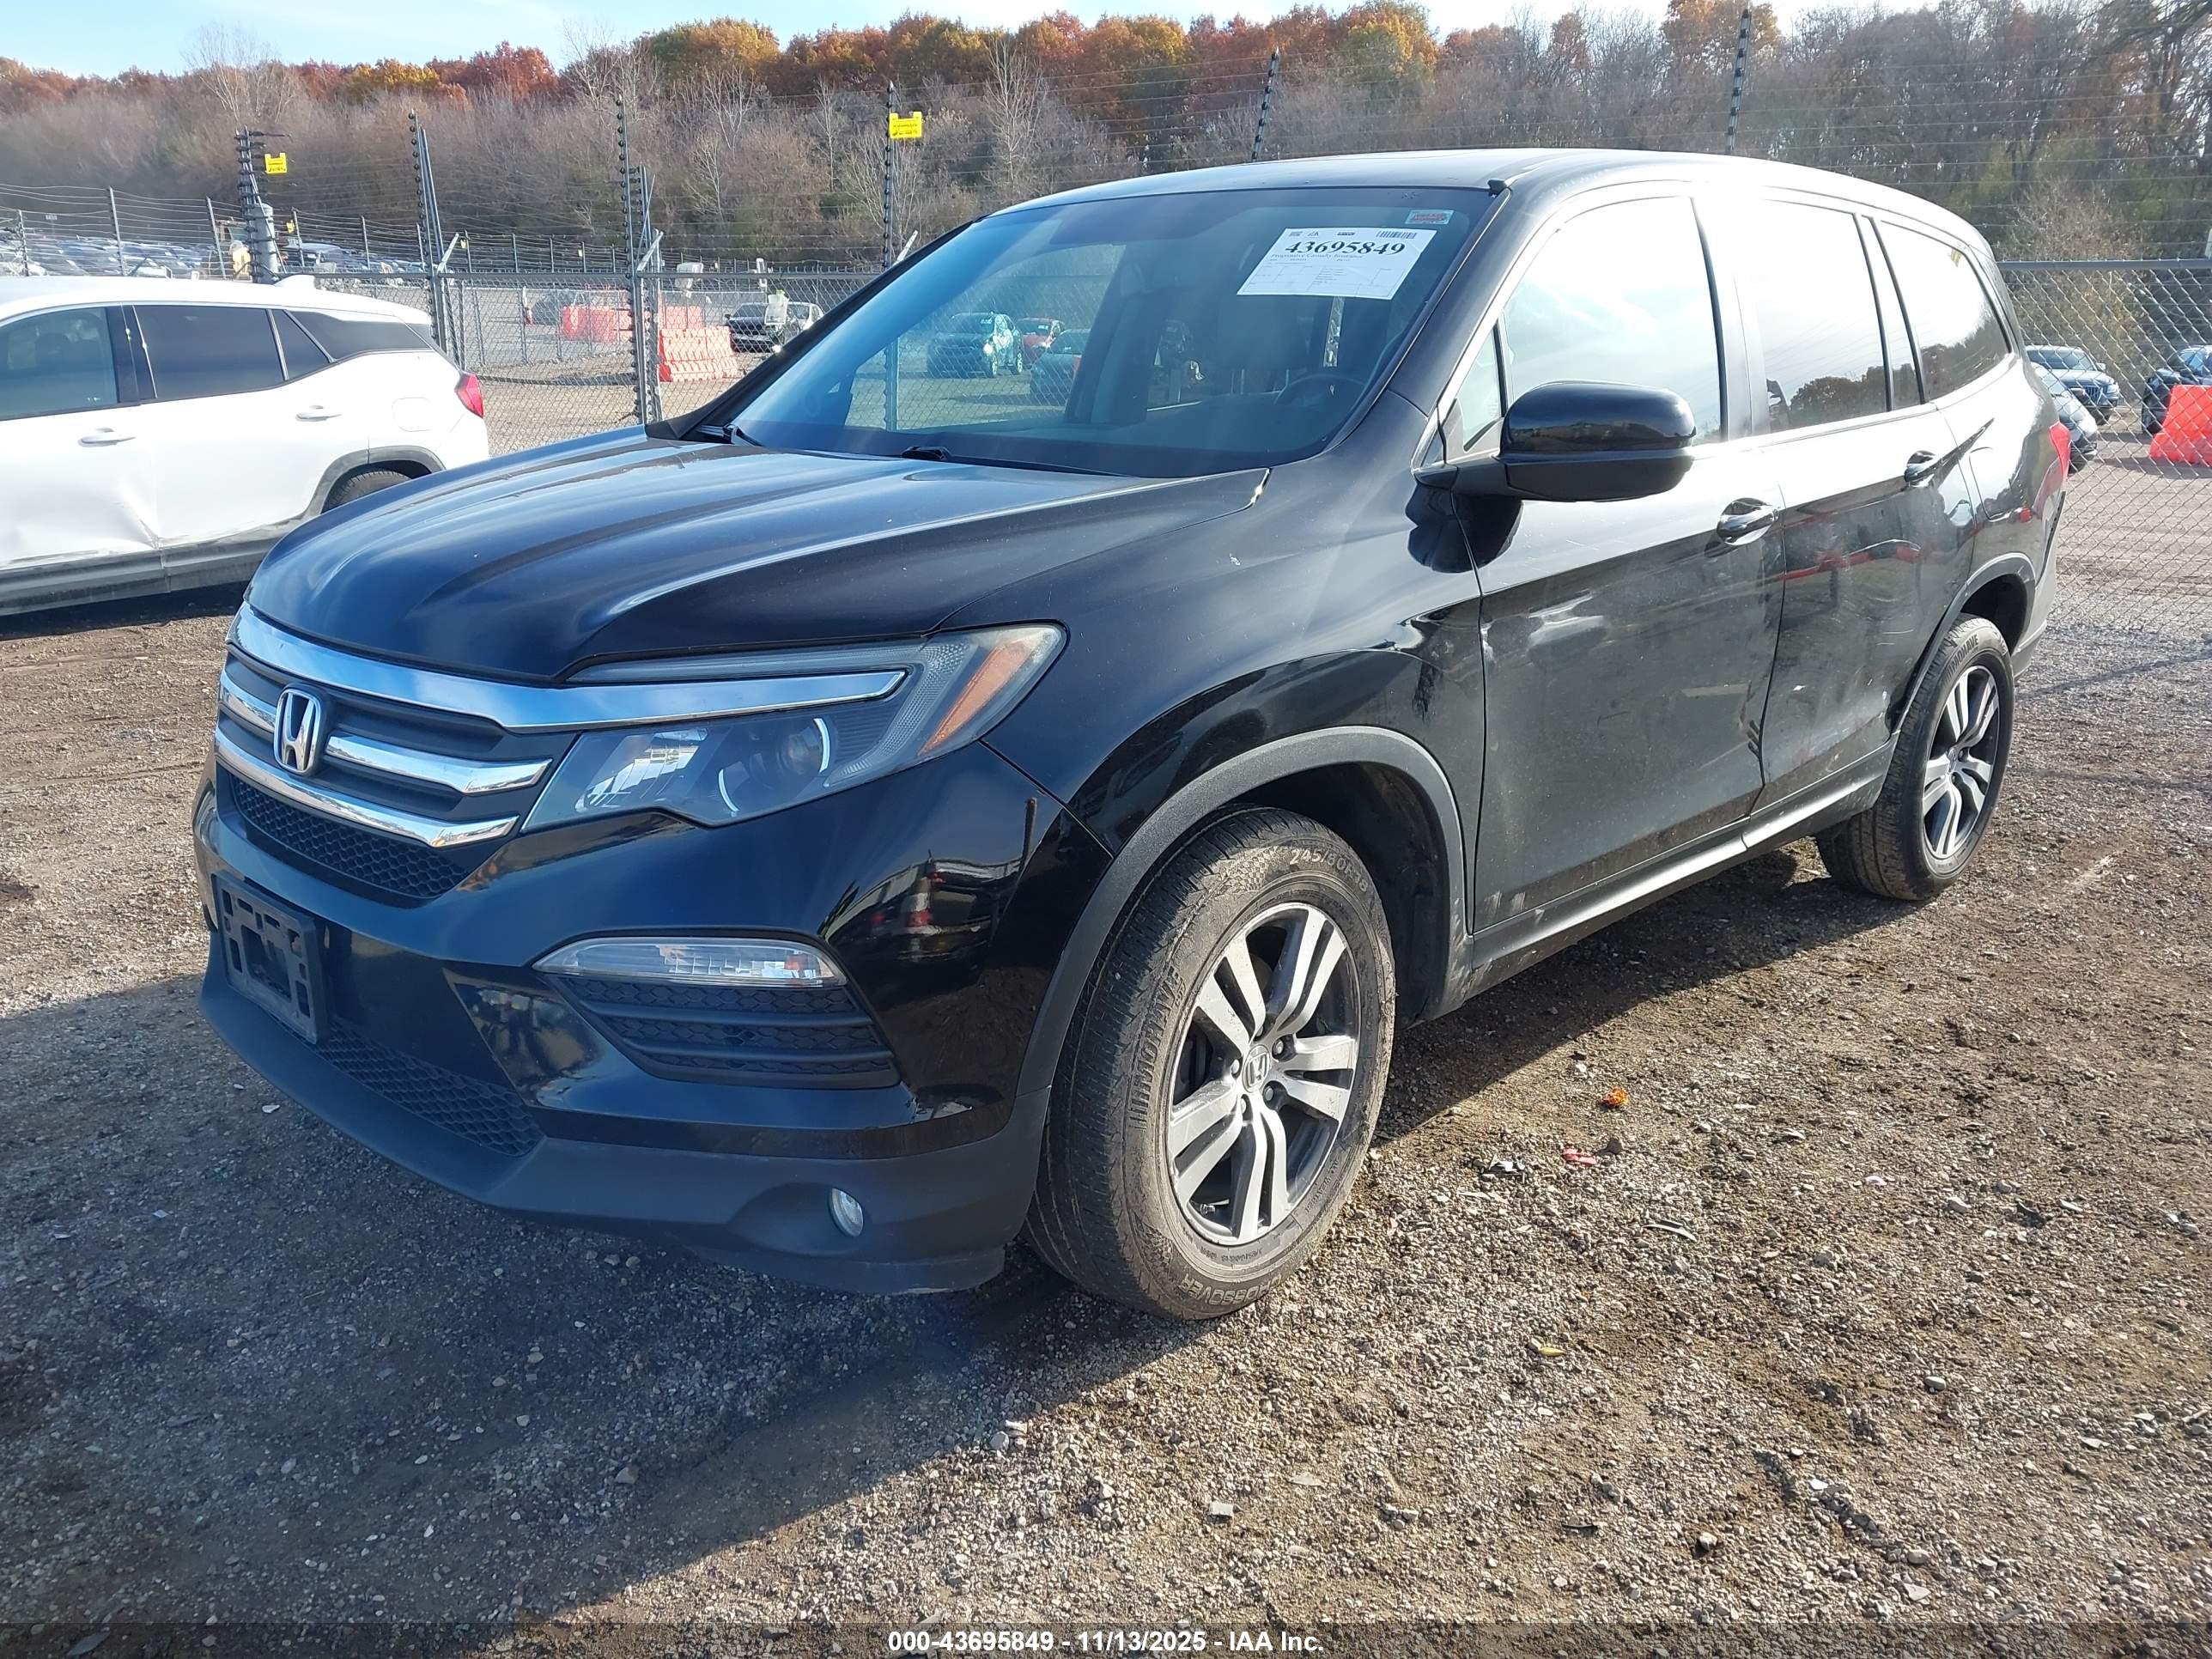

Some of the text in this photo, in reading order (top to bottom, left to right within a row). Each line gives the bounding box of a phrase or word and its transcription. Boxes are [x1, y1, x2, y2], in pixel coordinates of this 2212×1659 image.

[1285, 240, 1406, 256] 43695849
[1132, 962, 1182, 1084] MOHAVE
[1177, 1273, 1282, 1305] CROSSOVER
